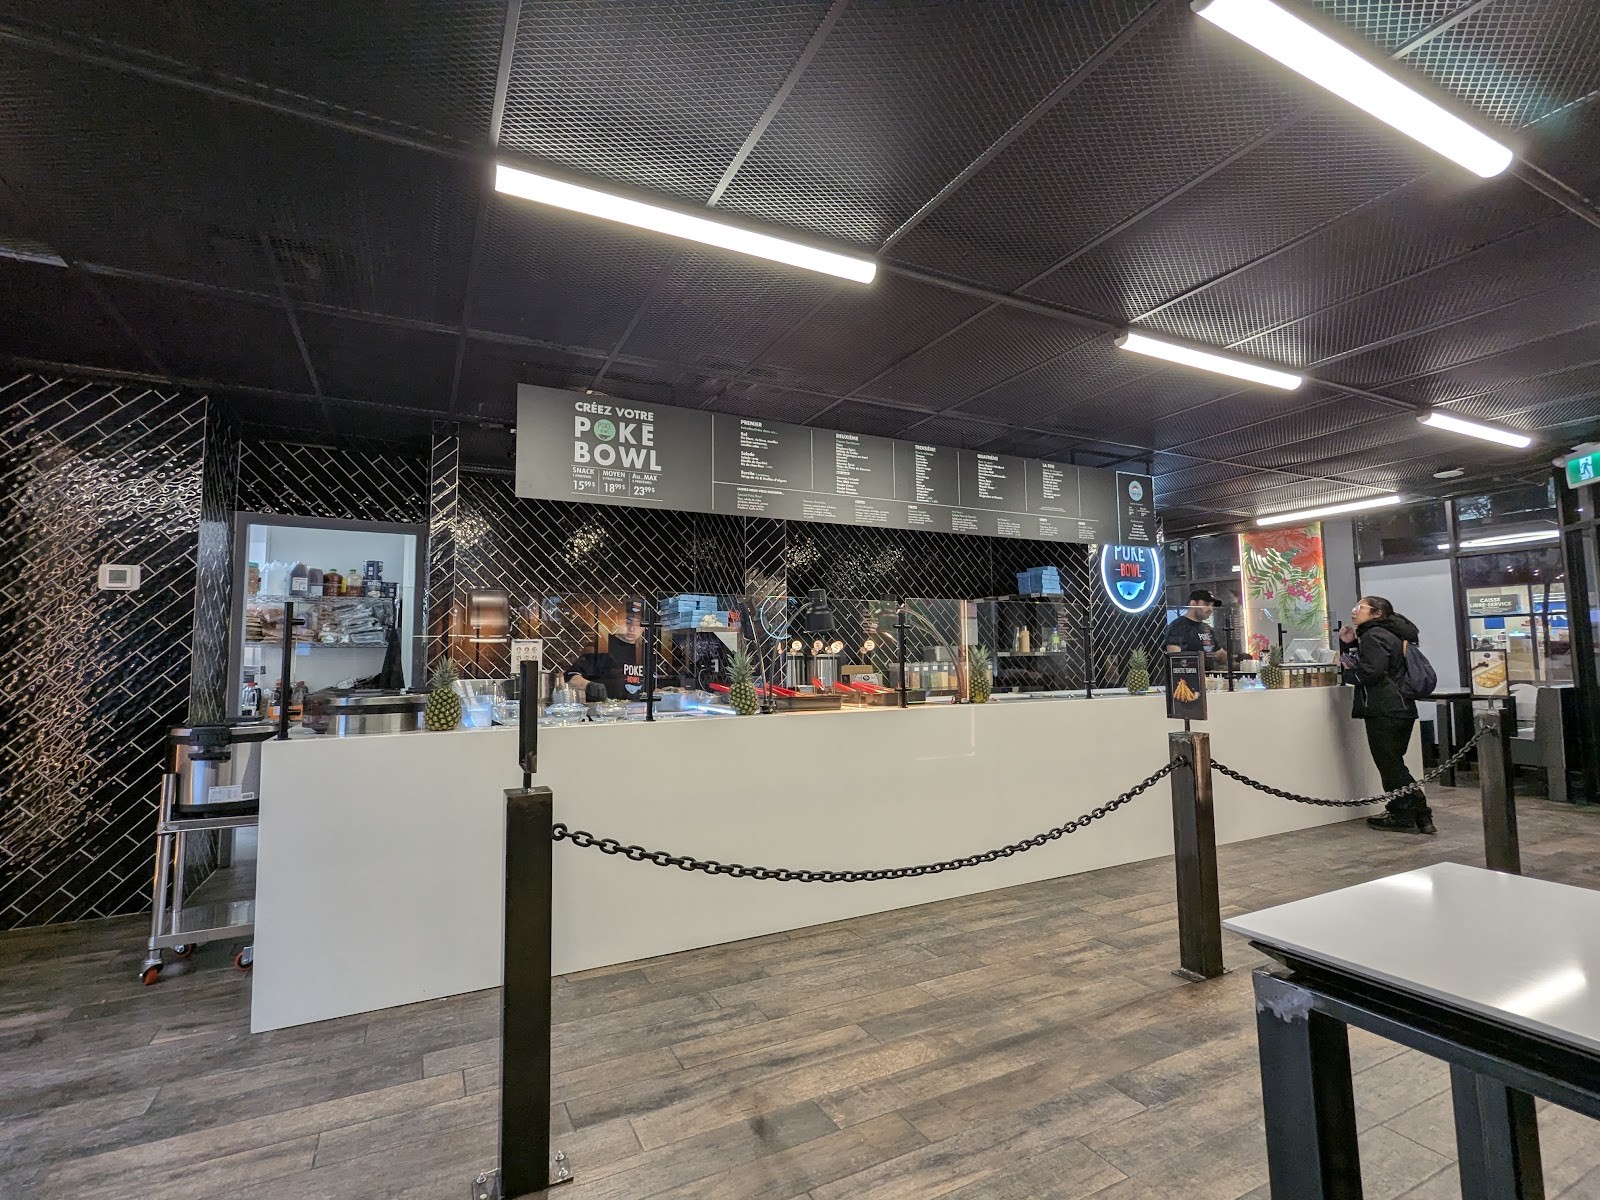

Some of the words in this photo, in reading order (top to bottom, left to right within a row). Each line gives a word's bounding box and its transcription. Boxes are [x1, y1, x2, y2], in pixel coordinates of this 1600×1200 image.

[575, 402, 612, 415] CRÉEZ
[615, 407, 654, 421] VOTRE
[740, 419, 762, 427] PREMIER
[574, 441, 661, 471] BOWL
[603, 470, 625, 478] MOYEN
[1115, 546, 1145, 562] POKE
[1120, 563, 1141, 577] BOWL
[624, 664, 643, 676] POKE
